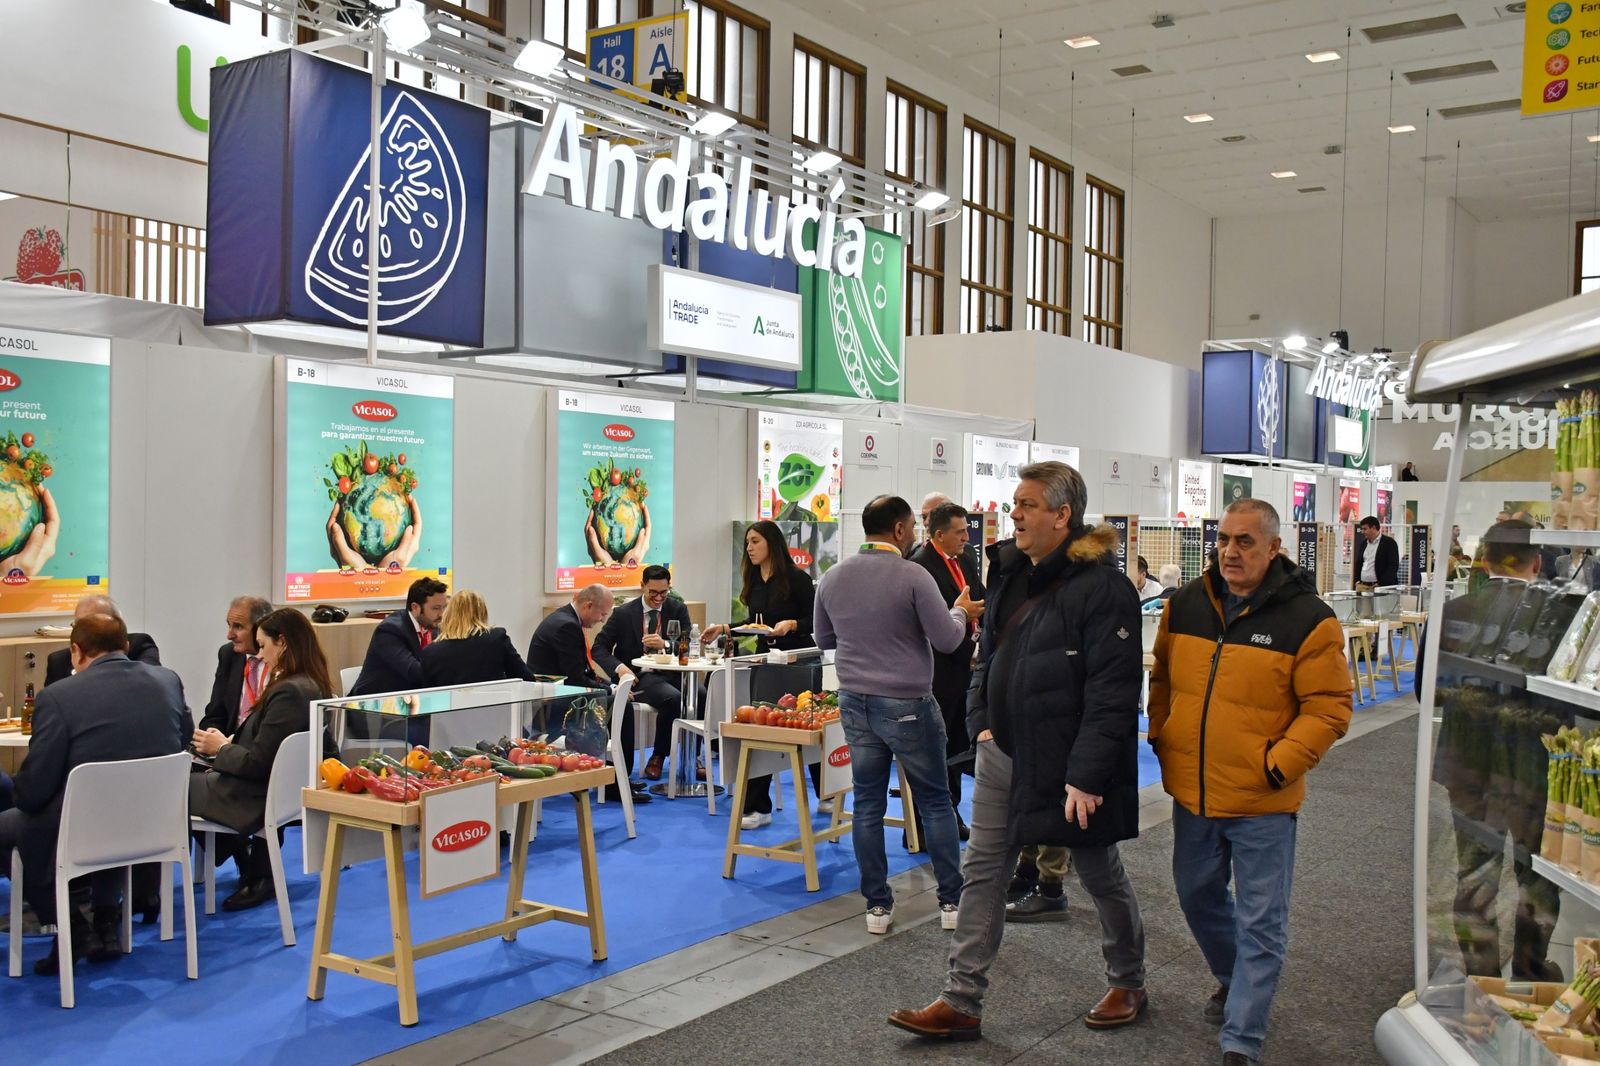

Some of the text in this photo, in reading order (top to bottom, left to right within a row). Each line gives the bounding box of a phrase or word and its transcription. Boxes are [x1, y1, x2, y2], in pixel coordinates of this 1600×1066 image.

[1580, 3, 1600, 13] Far
[650, 27, 673, 40] Aisle
[603, 36, 621, 48] Hall
[649, 43, 671, 76] A
[597, 54, 625, 81] 18
[521, 98, 866, 280] Andalucía
[673, 311, 699, 325] TRADE
[766, 320, 779, 329] Junta
[766, 328, 773, 336] de
[297, 367, 408, 389] B-18 VICASOL
[3, 400, 41, 410] present
[354, 404, 395, 417] VICASOL
[565, 398, 643, 413] B-18 VICASOL
[14, 410, 47, 420] future
[330, 422, 369, 433] Trabajamos
[387, 427, 415, 436] presente
[604, 428, 633, 438] VICASOL
[321, 431, 425, 445] para garantizar nuestro futuro
[1184, 474, 1200, 485] United
[1184, 485, 1206, 499] Exporting
[1192, 496, 1207, 506] Future
[1307, 541, 1316, 572] NATURE
[1419, 540, 1427, 569] COSAFRA
[436, 826, 487, 849] VICASOL
